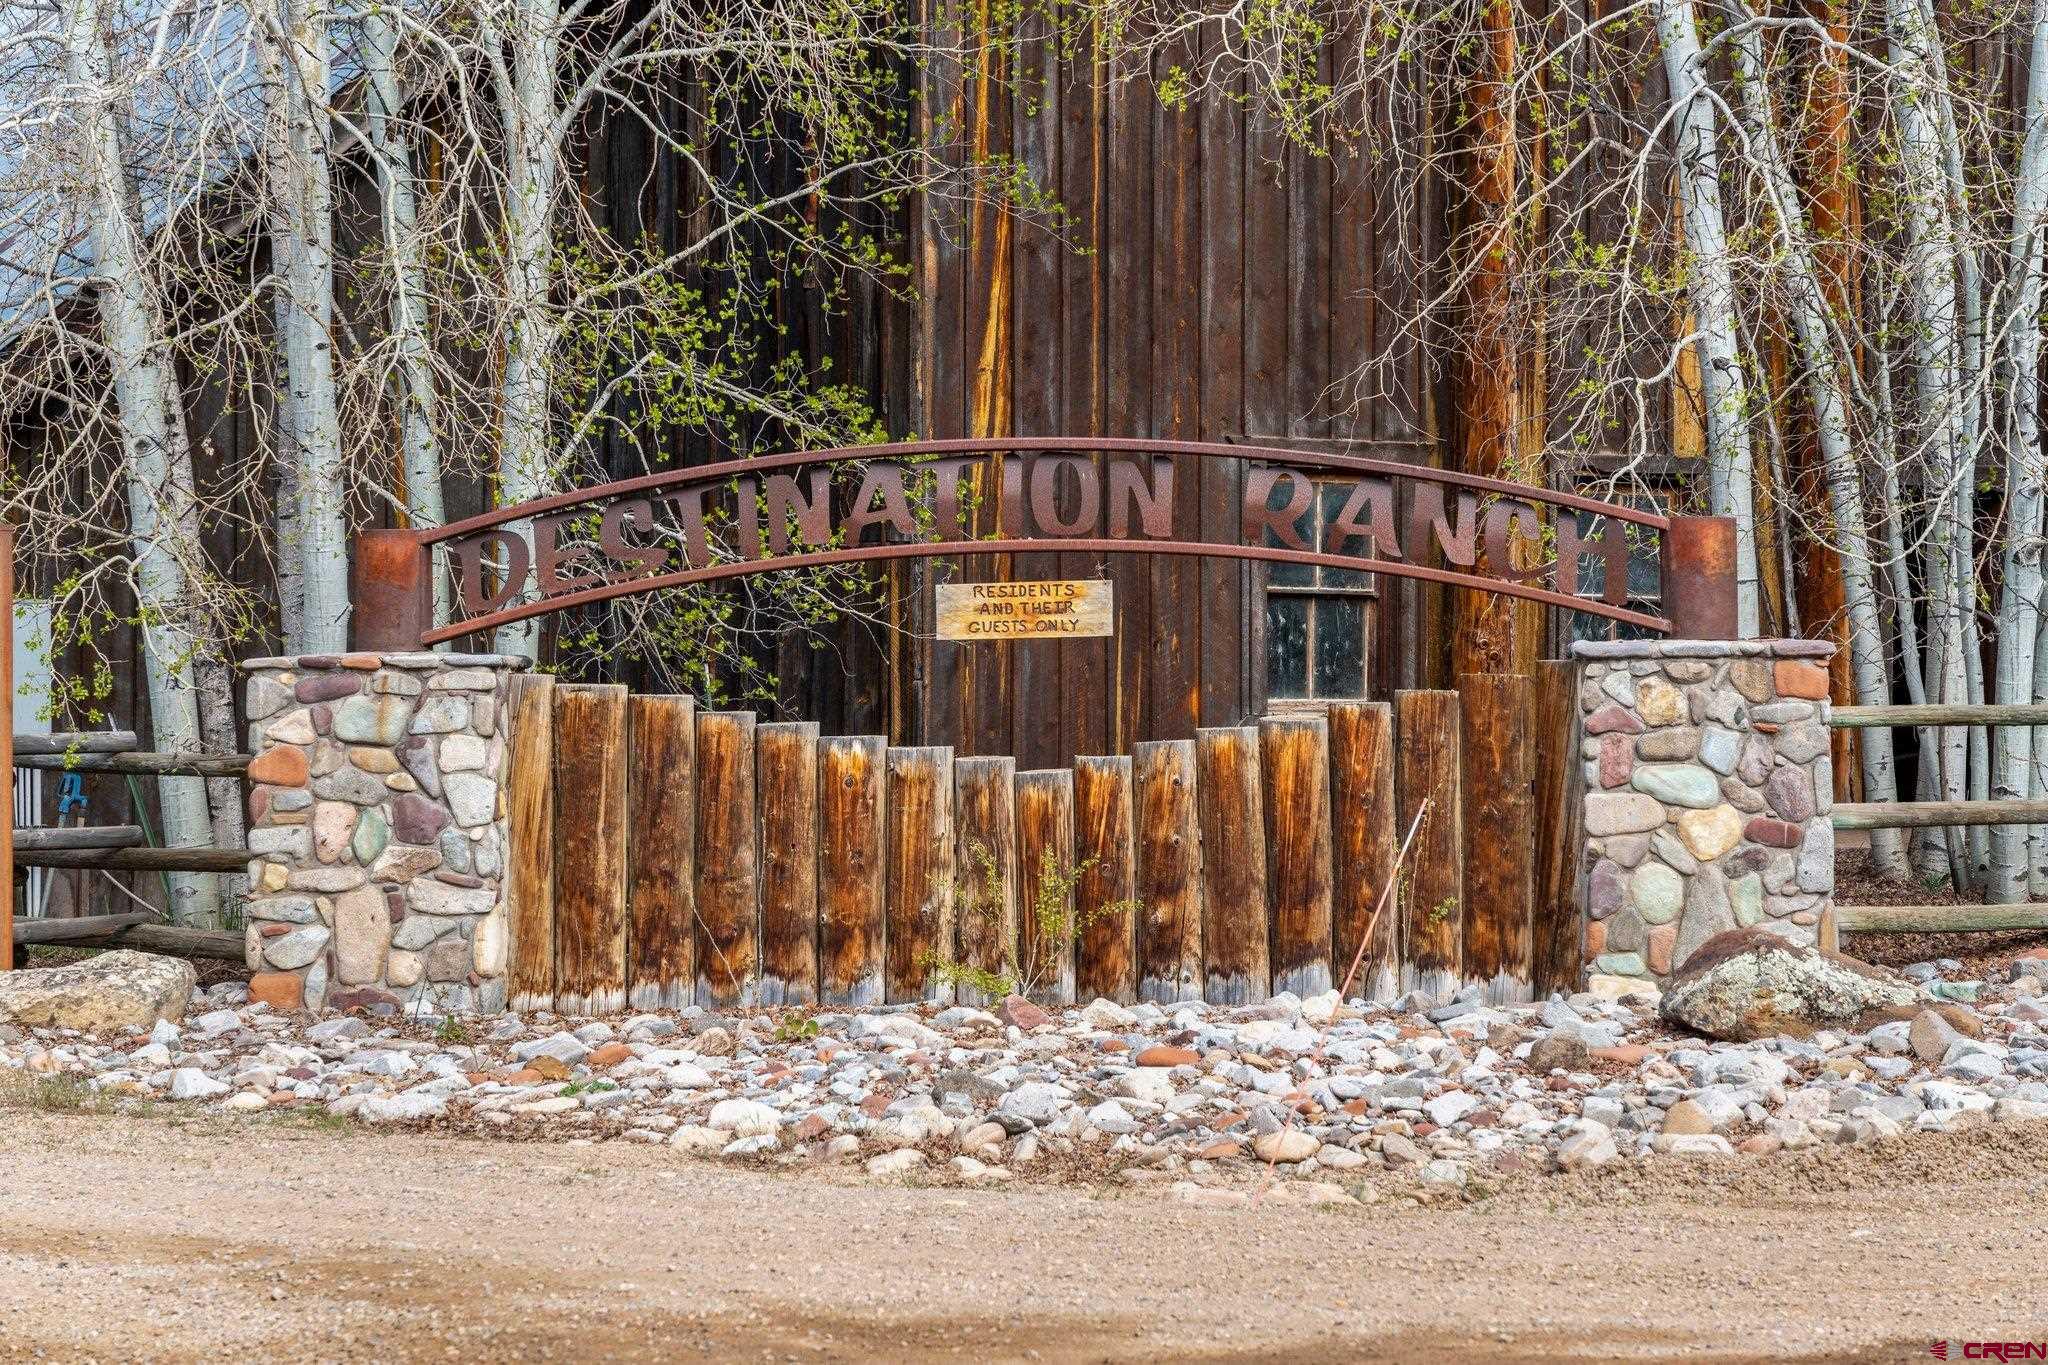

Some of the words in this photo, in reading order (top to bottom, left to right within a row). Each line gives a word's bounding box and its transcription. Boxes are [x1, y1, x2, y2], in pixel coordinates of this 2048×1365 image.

[453, 451, 1174, 613] DESTINATION
[1244, 463, 1629, 606] RANCH
[973, 584, 1075, 598] RESIDENTS
[979, 602, 1013, 615] AND
[1019, 600, 1075, 615] THEIR
[967, 620, 1028, 633] GUESTS
[1034, 619, 1079, 633] ONLY
